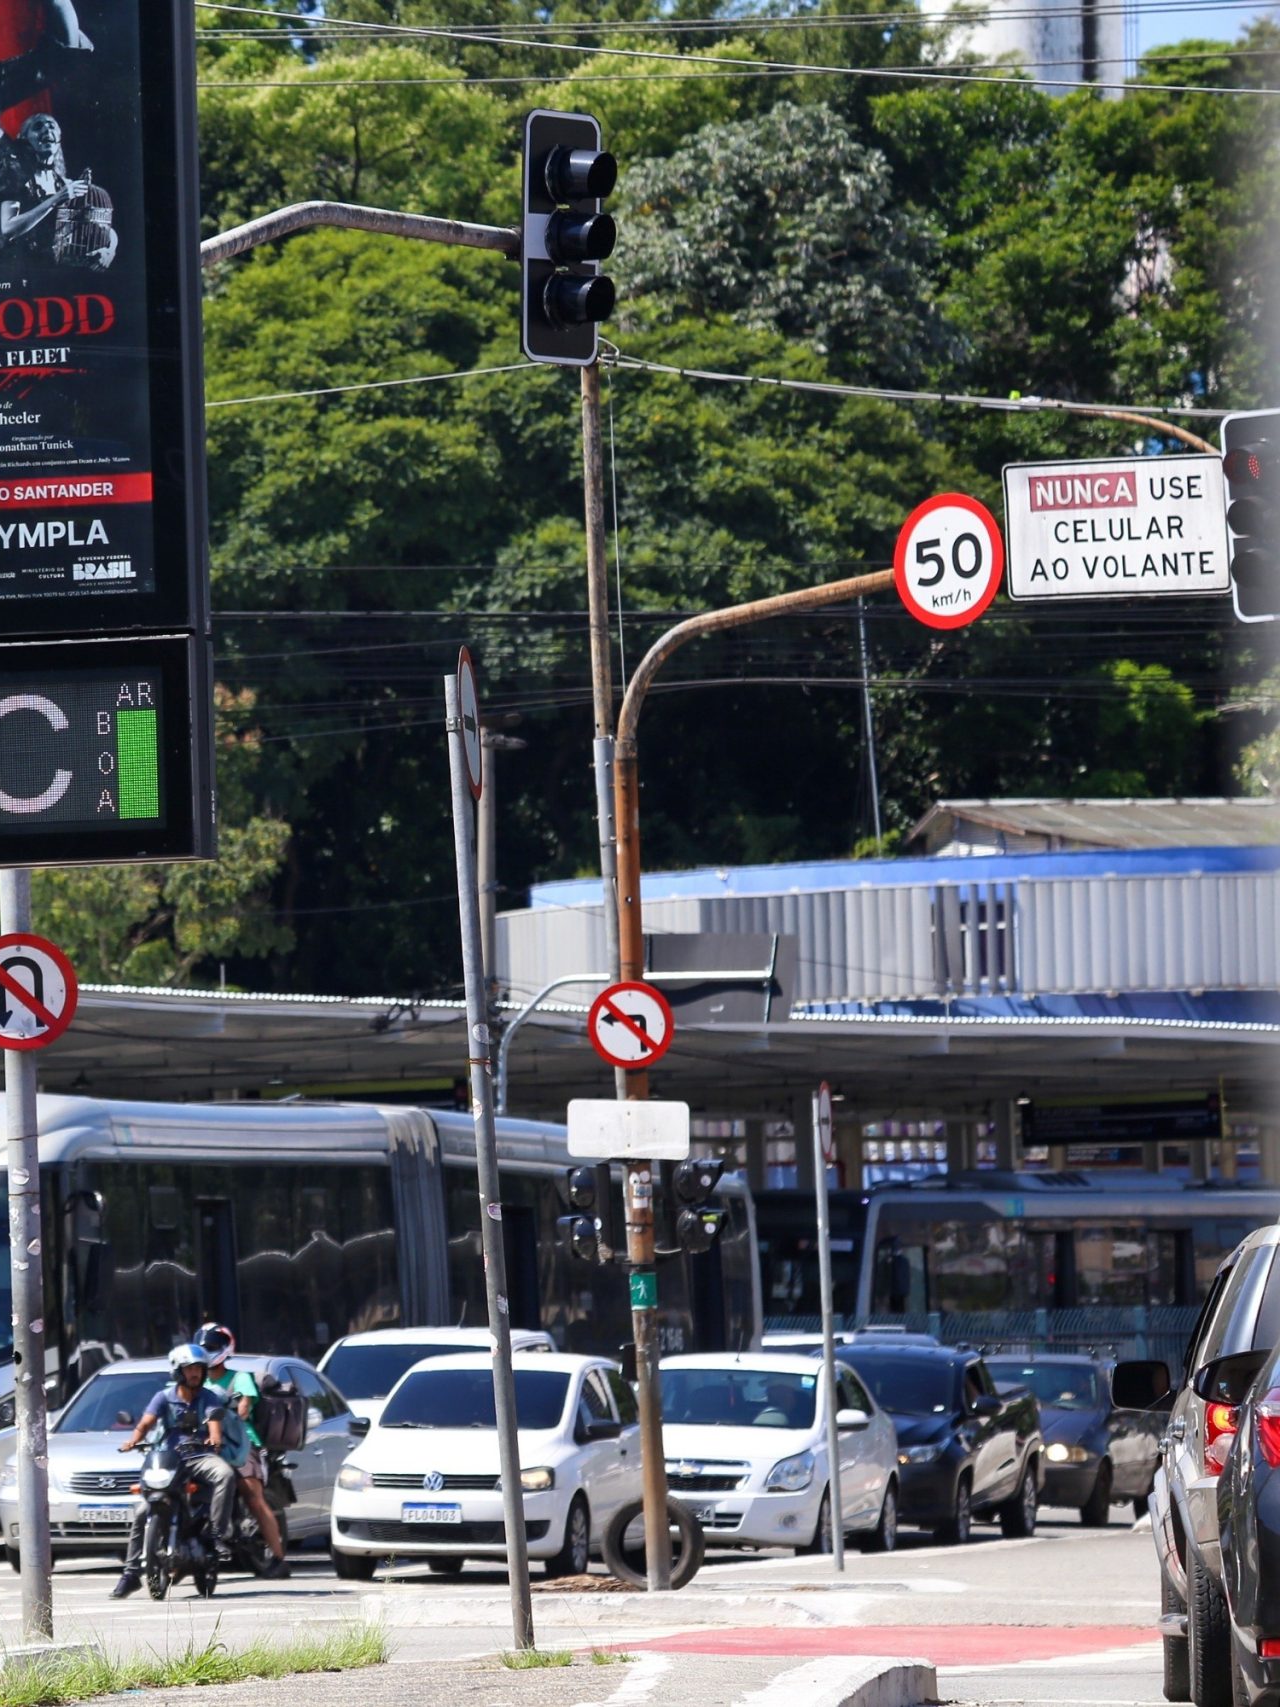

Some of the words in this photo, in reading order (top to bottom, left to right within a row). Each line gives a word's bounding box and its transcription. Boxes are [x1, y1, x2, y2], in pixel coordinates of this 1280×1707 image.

[7, 347, 70, 367] FLEET
[3, 401, 13, 409] de
[39, 439, 74, 450] Tunick
[13, 481, 114, 501] SANTANDER
[1035, 476, 1133, 507] NUNCA
[1149, 475, 1203, 500] USE
[1053, 515, 1184, 544] CELULAR
[915, 532, 983, 587] 50
[1030, 556, 1070, 582] AO
[1081, 550, 1215, 580] VOLANTE
[72, 561, 137, 581] BRASIL
[931, 587, 972, 608] km/h
[116, 681, 154, 707] AR
